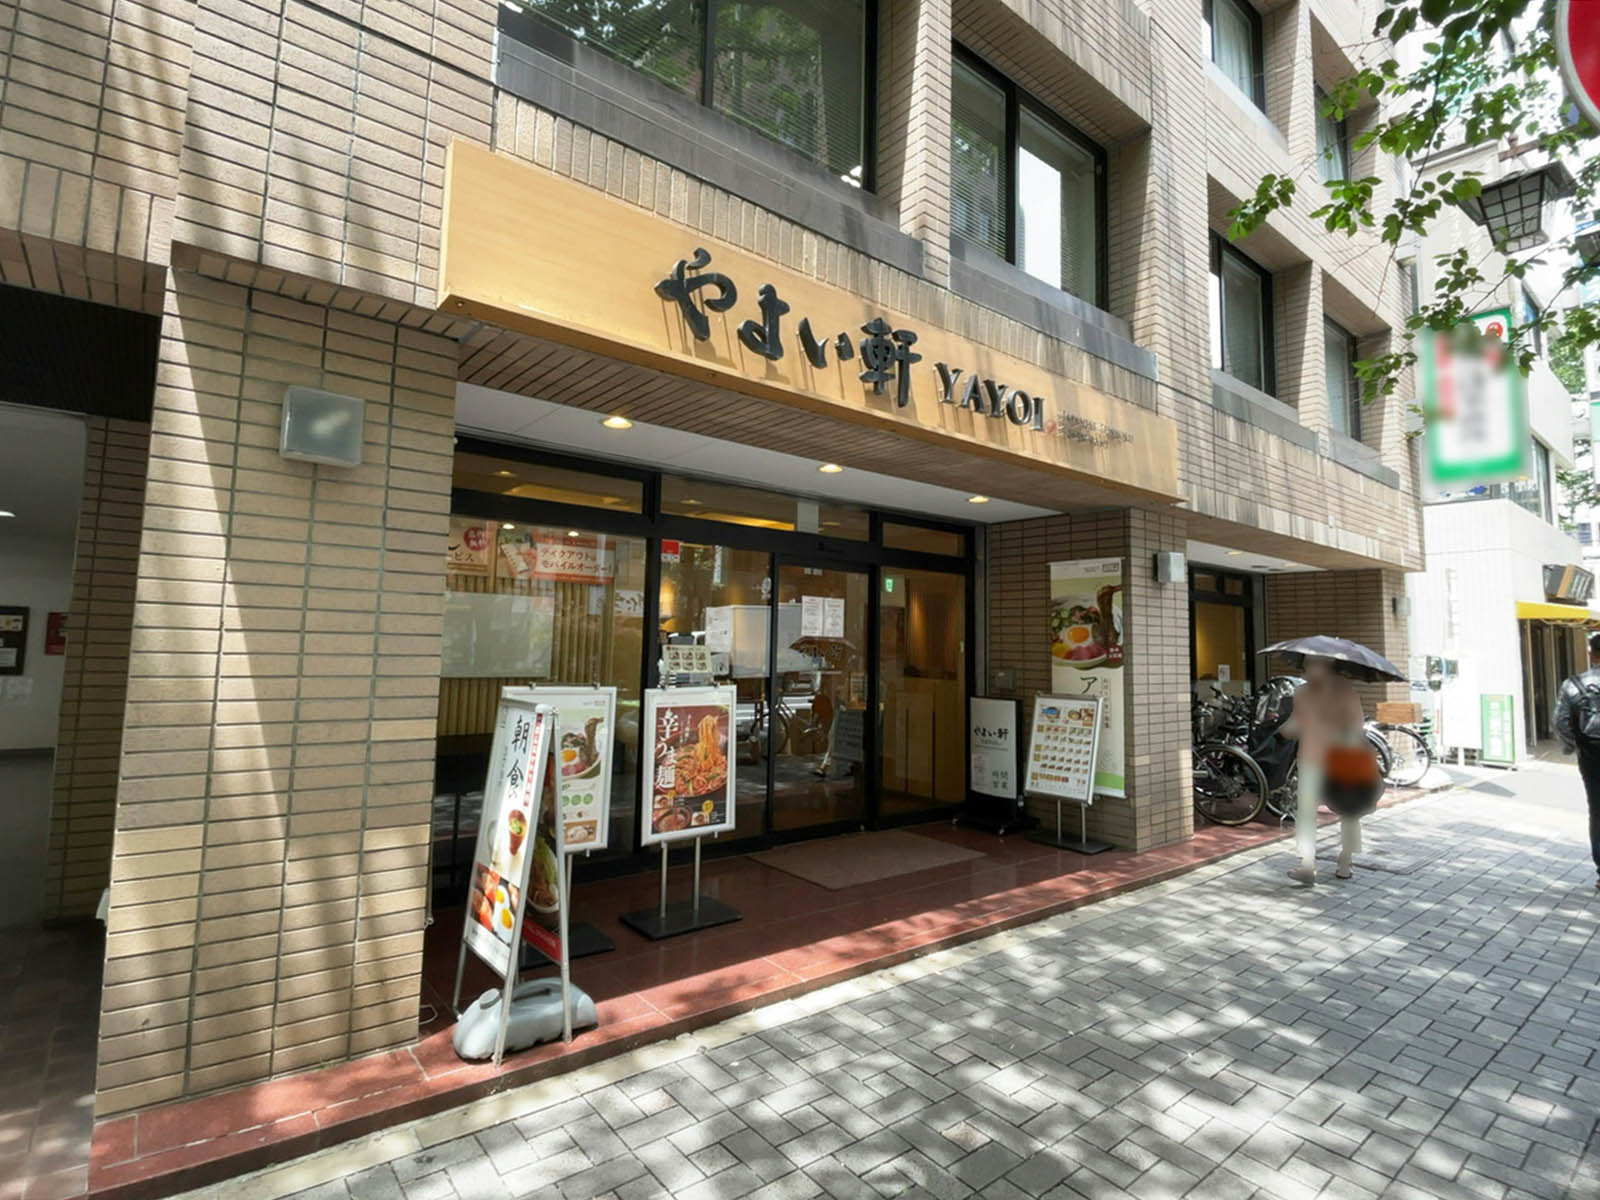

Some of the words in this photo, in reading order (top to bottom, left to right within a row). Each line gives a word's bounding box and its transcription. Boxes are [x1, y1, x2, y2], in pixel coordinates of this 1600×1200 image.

[654, 247, 922, 408] やよい軒
[934, 362, 1045, 431] YAYOI
[507, 714, 530, 789] 朝食
